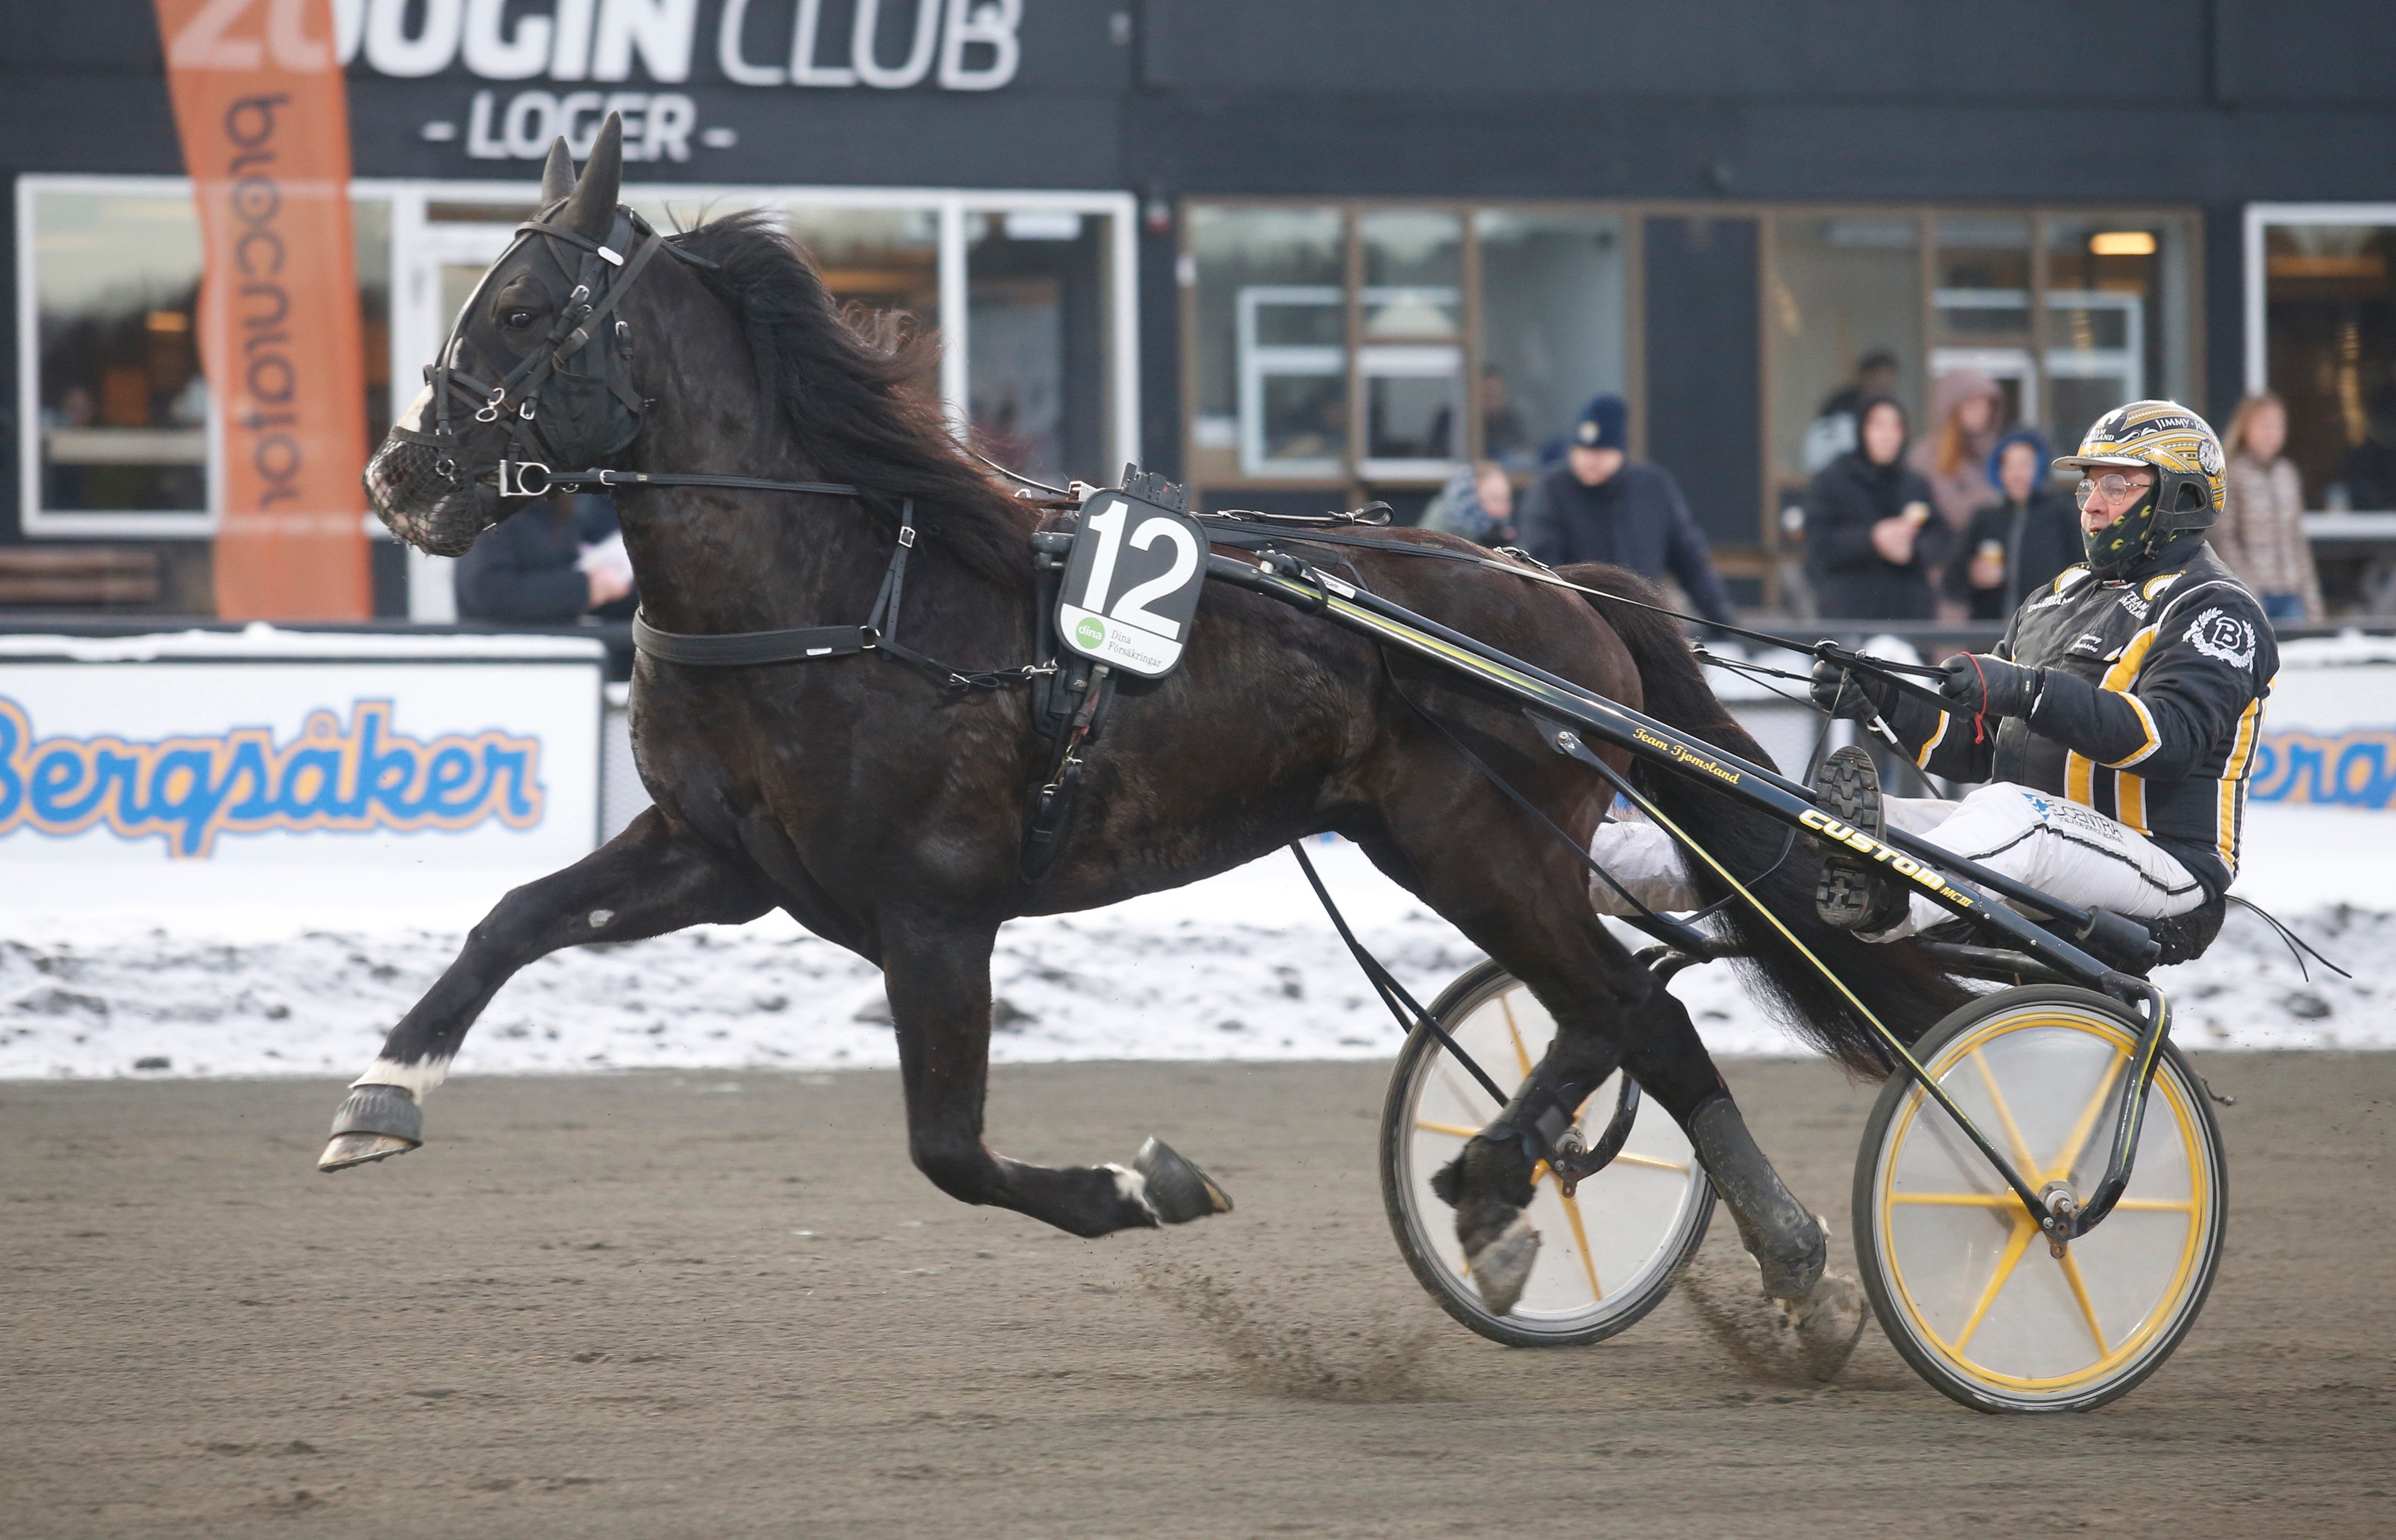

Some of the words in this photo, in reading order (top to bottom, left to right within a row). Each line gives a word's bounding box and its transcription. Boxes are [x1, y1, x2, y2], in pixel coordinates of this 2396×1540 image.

[716, 0, 1023, 91] CLUB
[2155, 417, 2189, 431] JIMMY
[1082, 500, 1199, 640] 12
[1078, 625, 1103, 640] dina
[1111, 630, 1132, 644] Dina
[2211, 616, 2243, 650] B
[1108, 641, 1162, 668] Försäkringar
[1632, 728, 1668, 751] Team
[1670, 744, 1741, 785] Tjomsland
[1798, 809, 1946, 891] CUSTOM
